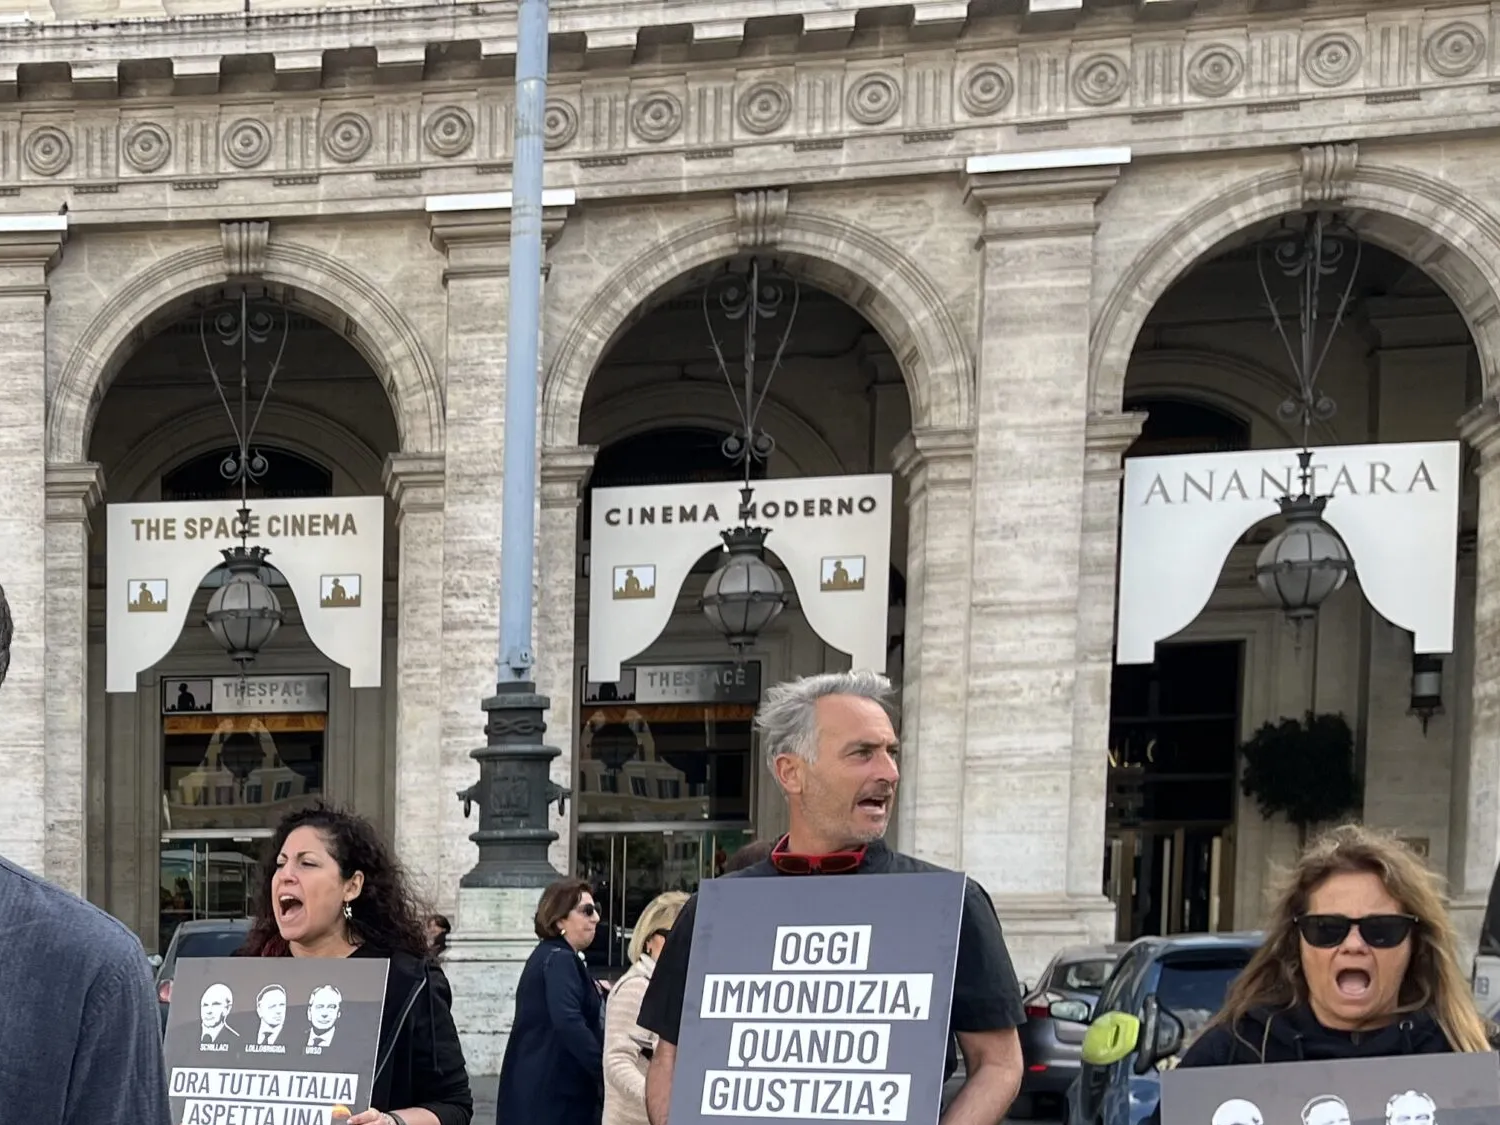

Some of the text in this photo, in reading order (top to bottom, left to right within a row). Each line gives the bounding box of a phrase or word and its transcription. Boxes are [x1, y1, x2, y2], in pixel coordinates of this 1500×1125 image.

[1141, 459, 1439, 506] ANANTARA
[131, 512, 358, 541] THE SPACE CINEMA
[604, 496, 877, 527] CINEMA MODERNO
[780, 931, 861, 965] OGGI
[708, 980, 922, 1019] IMMONDIZIA,
[738, 1029, 880, 1067] QUANDO
[173, 1071, 353, 1101] ORA TUTTA ITALIA
[708, 1077, 900, 1115] GIUSTIZIA?
